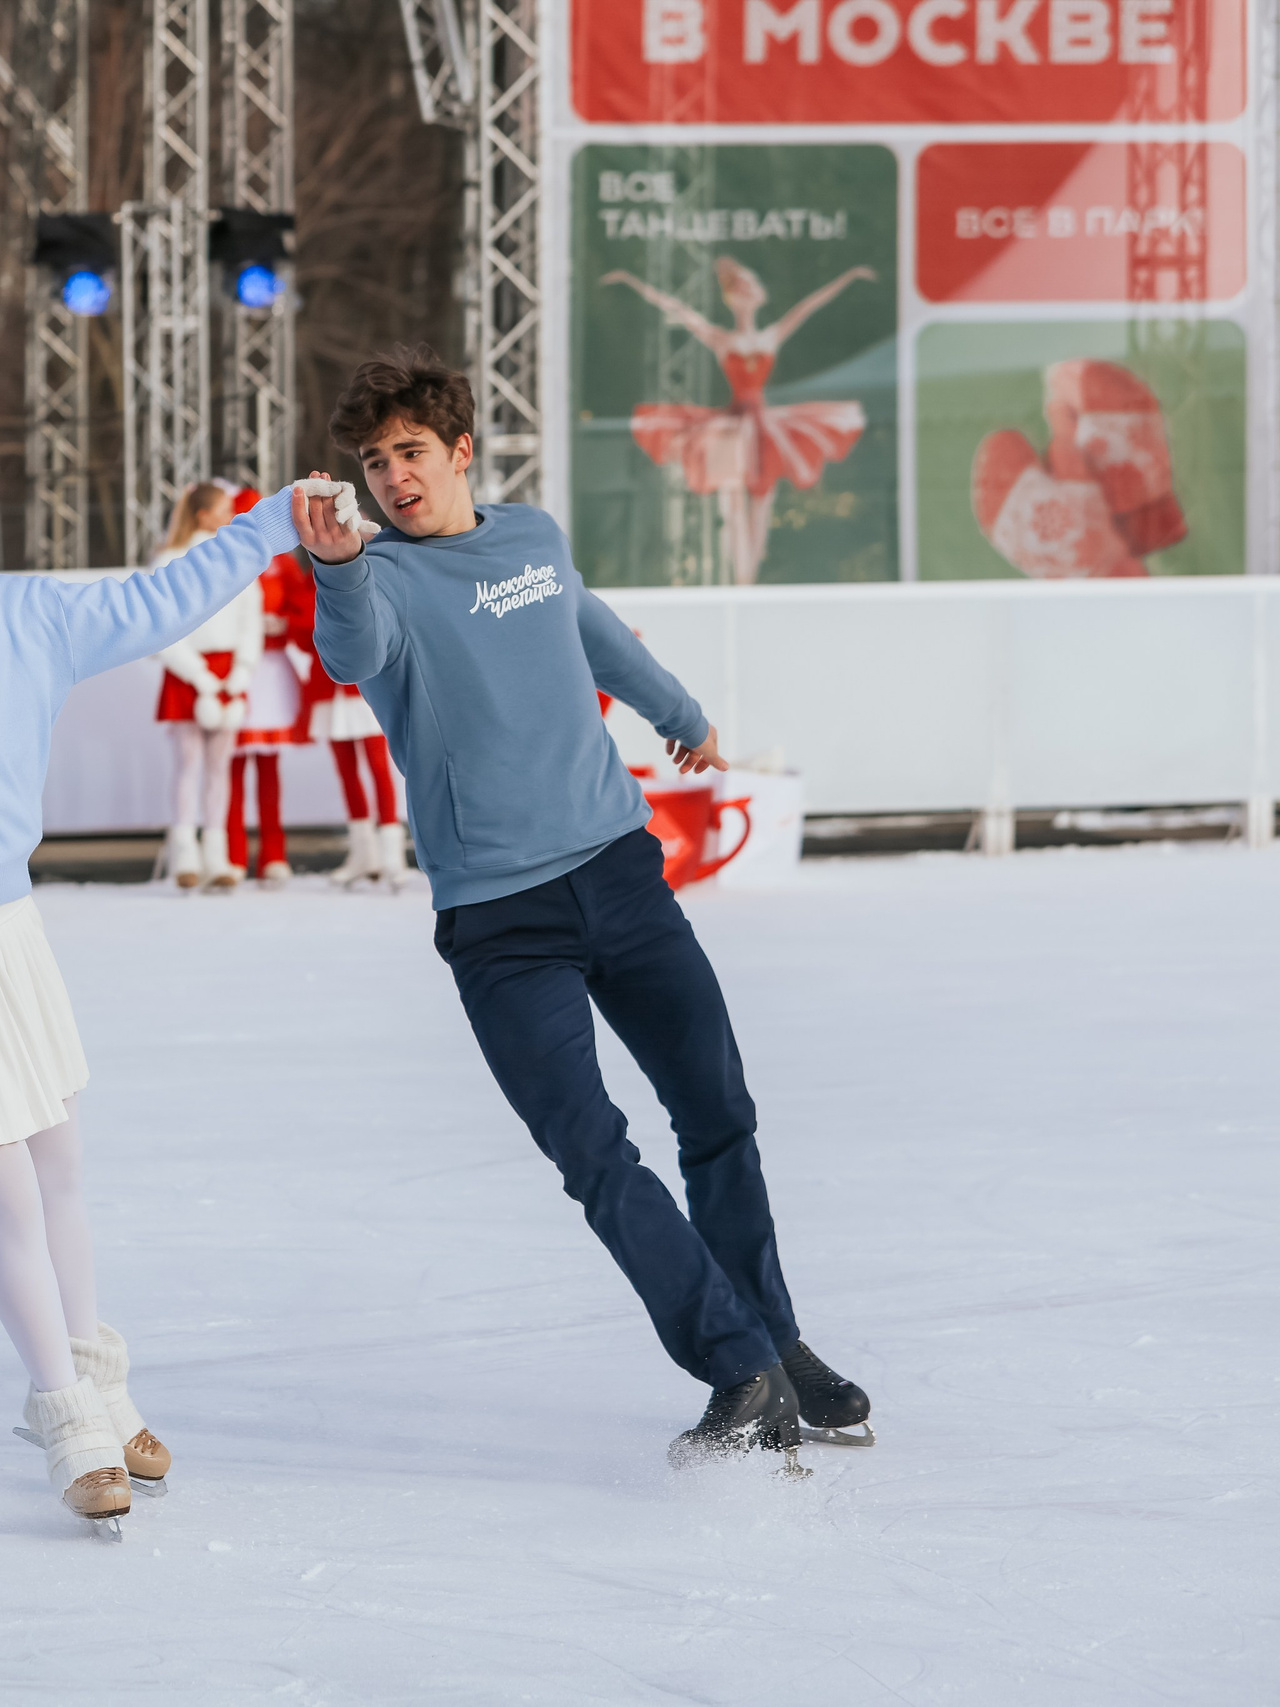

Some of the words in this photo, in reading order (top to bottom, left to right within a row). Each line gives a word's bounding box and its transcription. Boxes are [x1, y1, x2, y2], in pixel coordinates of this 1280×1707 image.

[642, 0, 706, 64] В
[742, 0, 1175, 67] МОСКВЕ
[599, 170, 674, 202] ВСЕ
[955, 205, 1038, 239] ВСЕ
[1047, 205, 1075, 239] В
[469, 564, 556, 614] Московское
